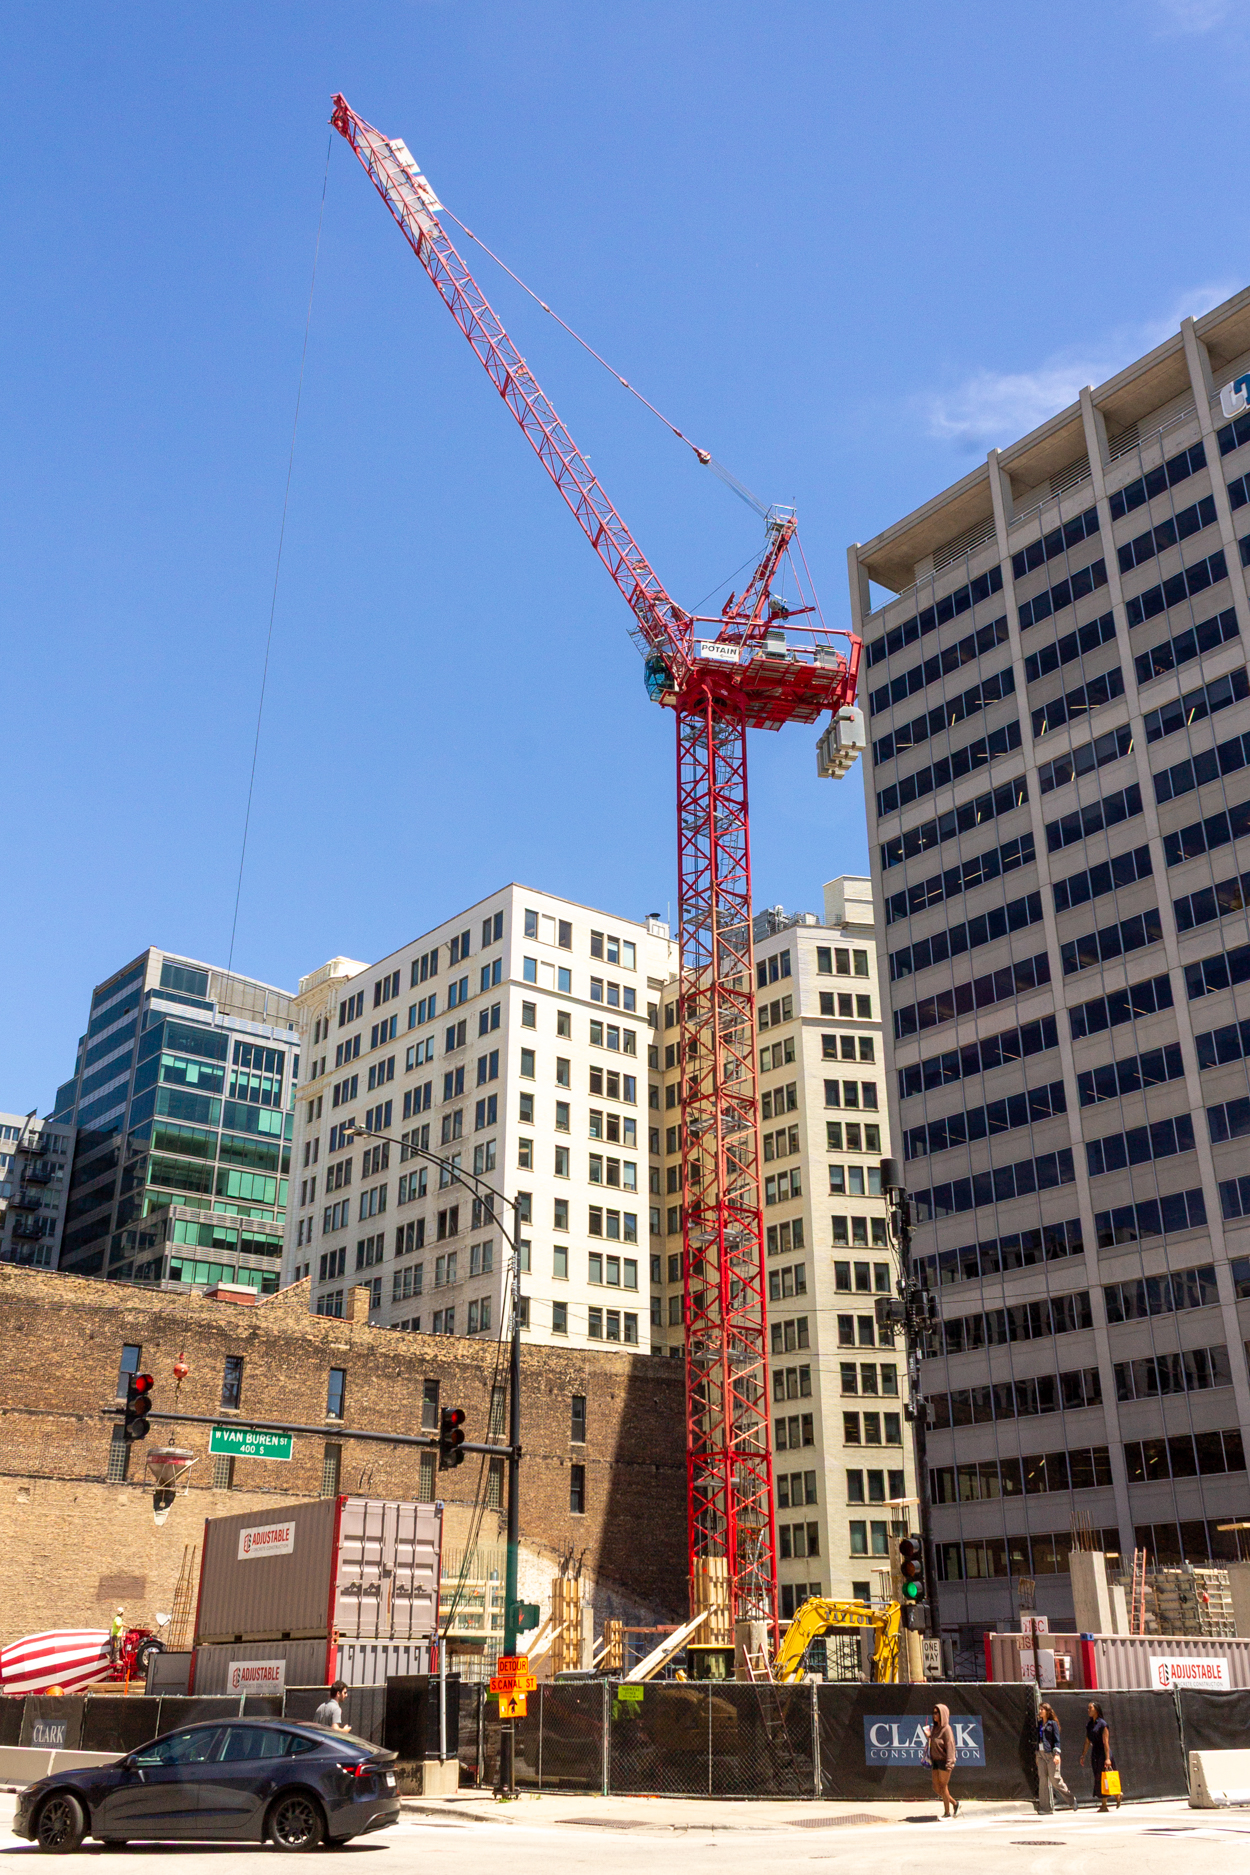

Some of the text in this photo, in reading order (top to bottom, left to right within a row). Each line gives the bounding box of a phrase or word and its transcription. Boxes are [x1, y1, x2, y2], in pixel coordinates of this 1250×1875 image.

[702, 645, 737, 655] POTAIN
[223, 1430, 243, 1442] VAN
[246, 1433, 278, 1446] BUREN
[280, 1438, 288, 1446] ST
[240, 1445, 264, 1454] 400 S
[252, 1528, 290, 1546] ADJUSTABLE
[924, 1642, 938, 1652] ONE
[924, 1653, 939, 1662] WAY
[500, 1661, 527, 1671] DETOUR
[241, 1667, 280, 1681] ADJUSTABLE
[1171, 1664, 1222, 1679] ADJUSTABLE
[526, 1678, 534, 1688] ST
[33, 1724, 65, 1743] CLARK
[869, 1723, 979, 1747] CLAK
[870, 1749, 980, 1759] CONSTRION
